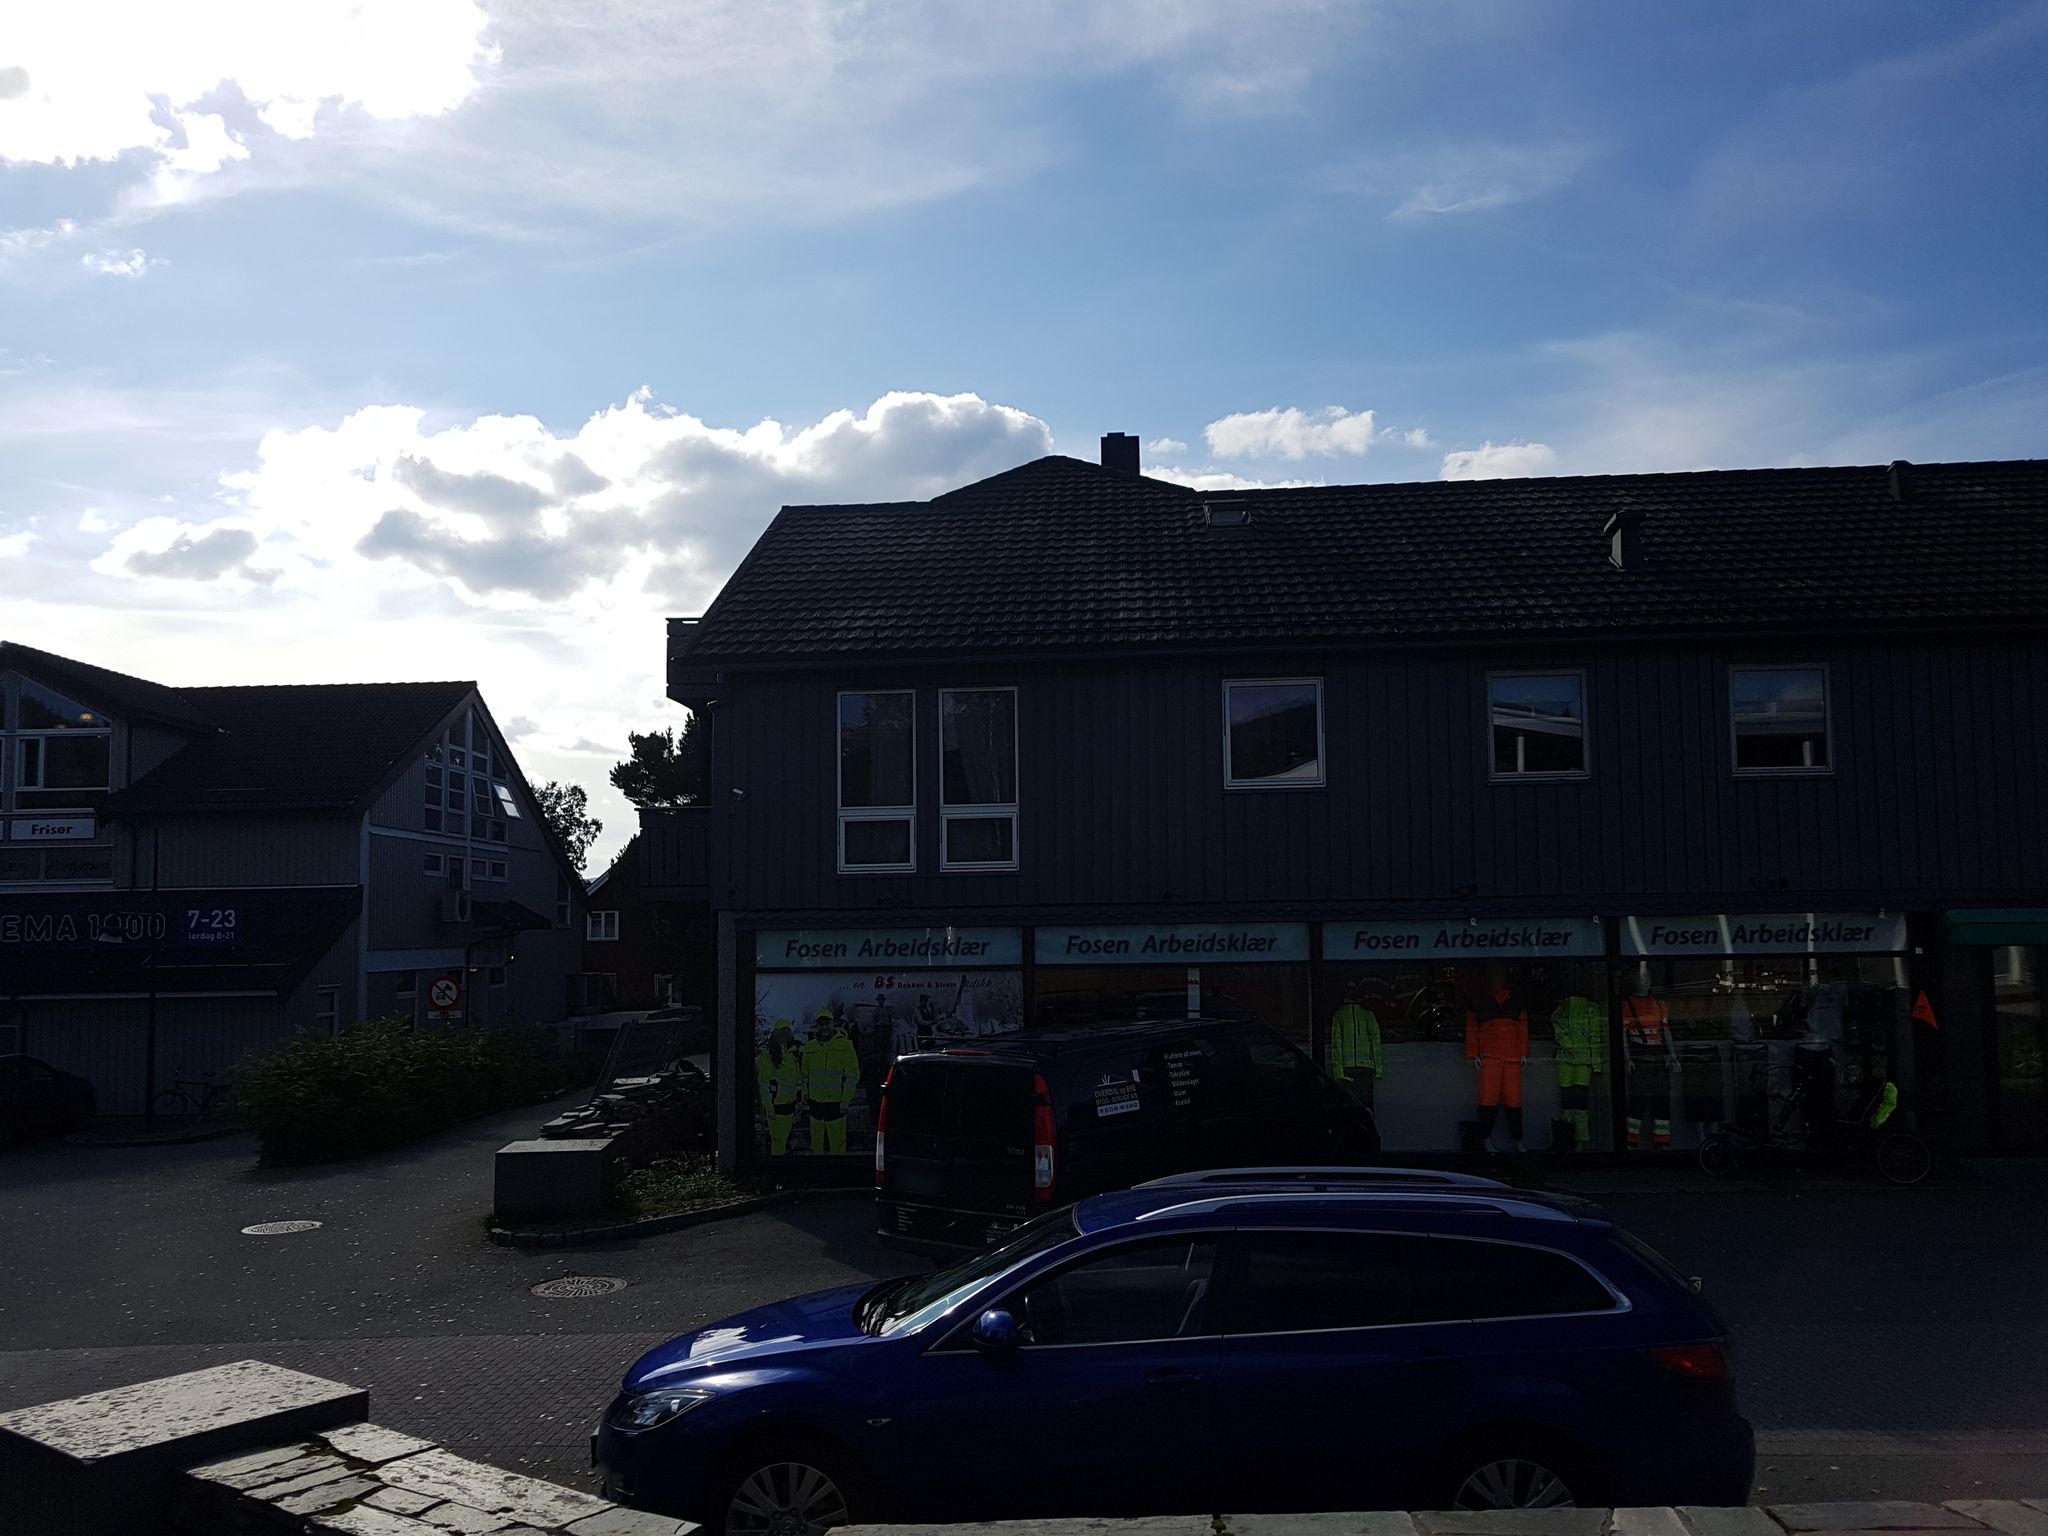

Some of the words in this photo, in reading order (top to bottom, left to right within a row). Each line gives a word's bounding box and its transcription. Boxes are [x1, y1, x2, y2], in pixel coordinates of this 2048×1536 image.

[187, 909, 236, 929] 7-23
[216, 931, 235, 940] 8-21
[1066, 935, 1130, 954] Fosen
[1142, 932, 1278, 953] Arbeidsklær
[1354, 931, 1420, 950] Fosen
[1433, 926, 1573, 948] Arbeidsklær
[1651, 925, 1718, 945] Fosen
[1731, 922, 1875, 943] Arbeidsklær
[785, 939, 847, 958] Fosen
[858, 936, 991, 957] Arbeidsklær
